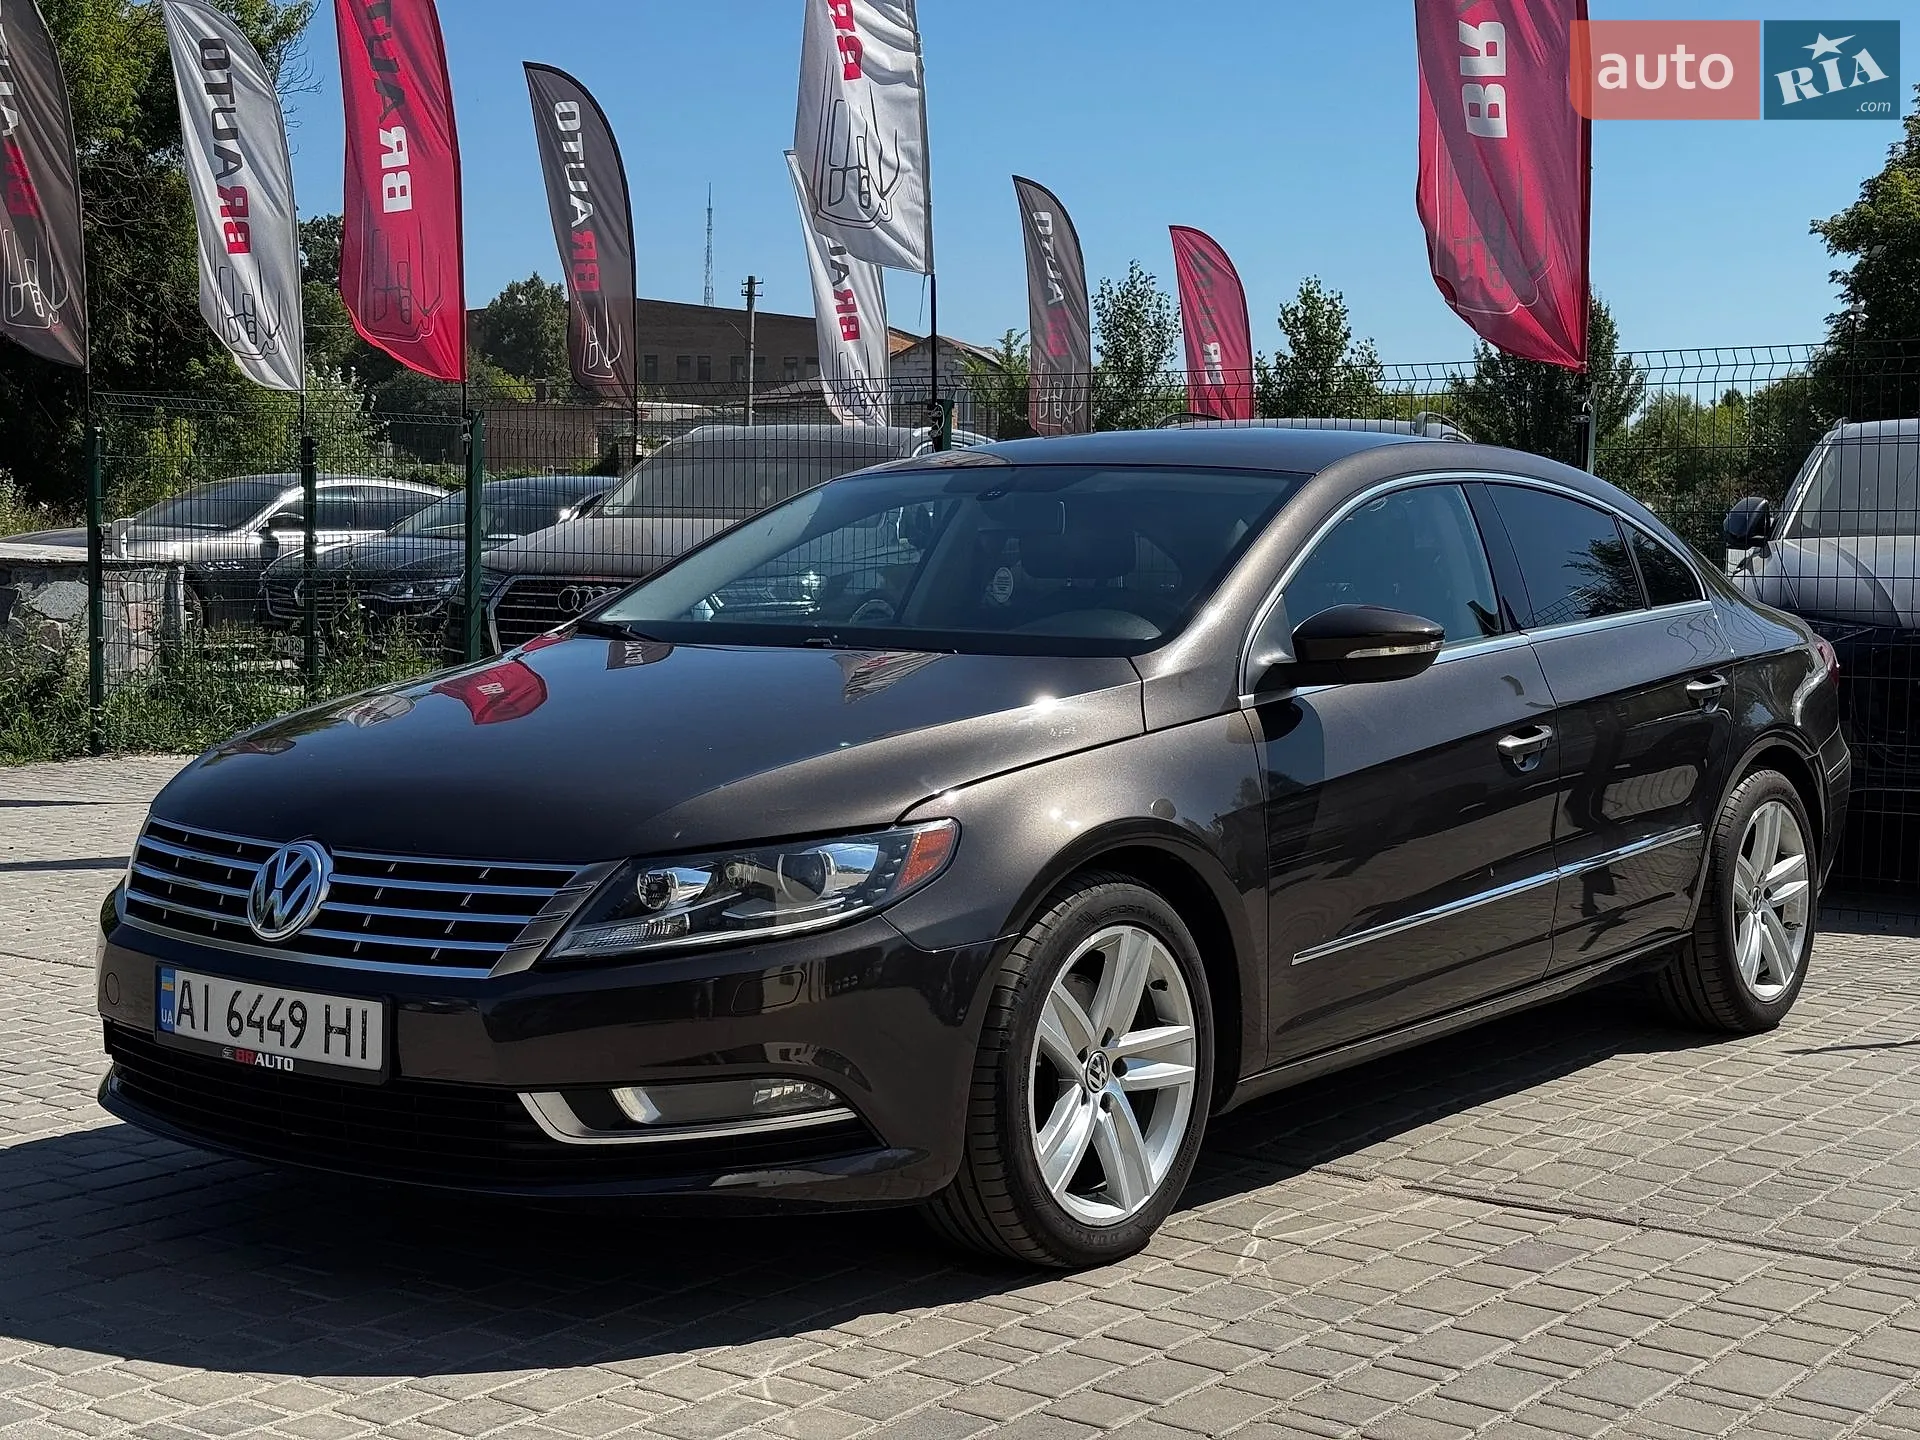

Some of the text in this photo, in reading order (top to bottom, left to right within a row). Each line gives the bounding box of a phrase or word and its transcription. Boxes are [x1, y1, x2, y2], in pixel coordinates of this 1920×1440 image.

[161, 1008, 174, 1025] UA
[176, 979, 367, 1060] AI 6449 HI
[233, 1051, 295, 1073] BRAUTO
